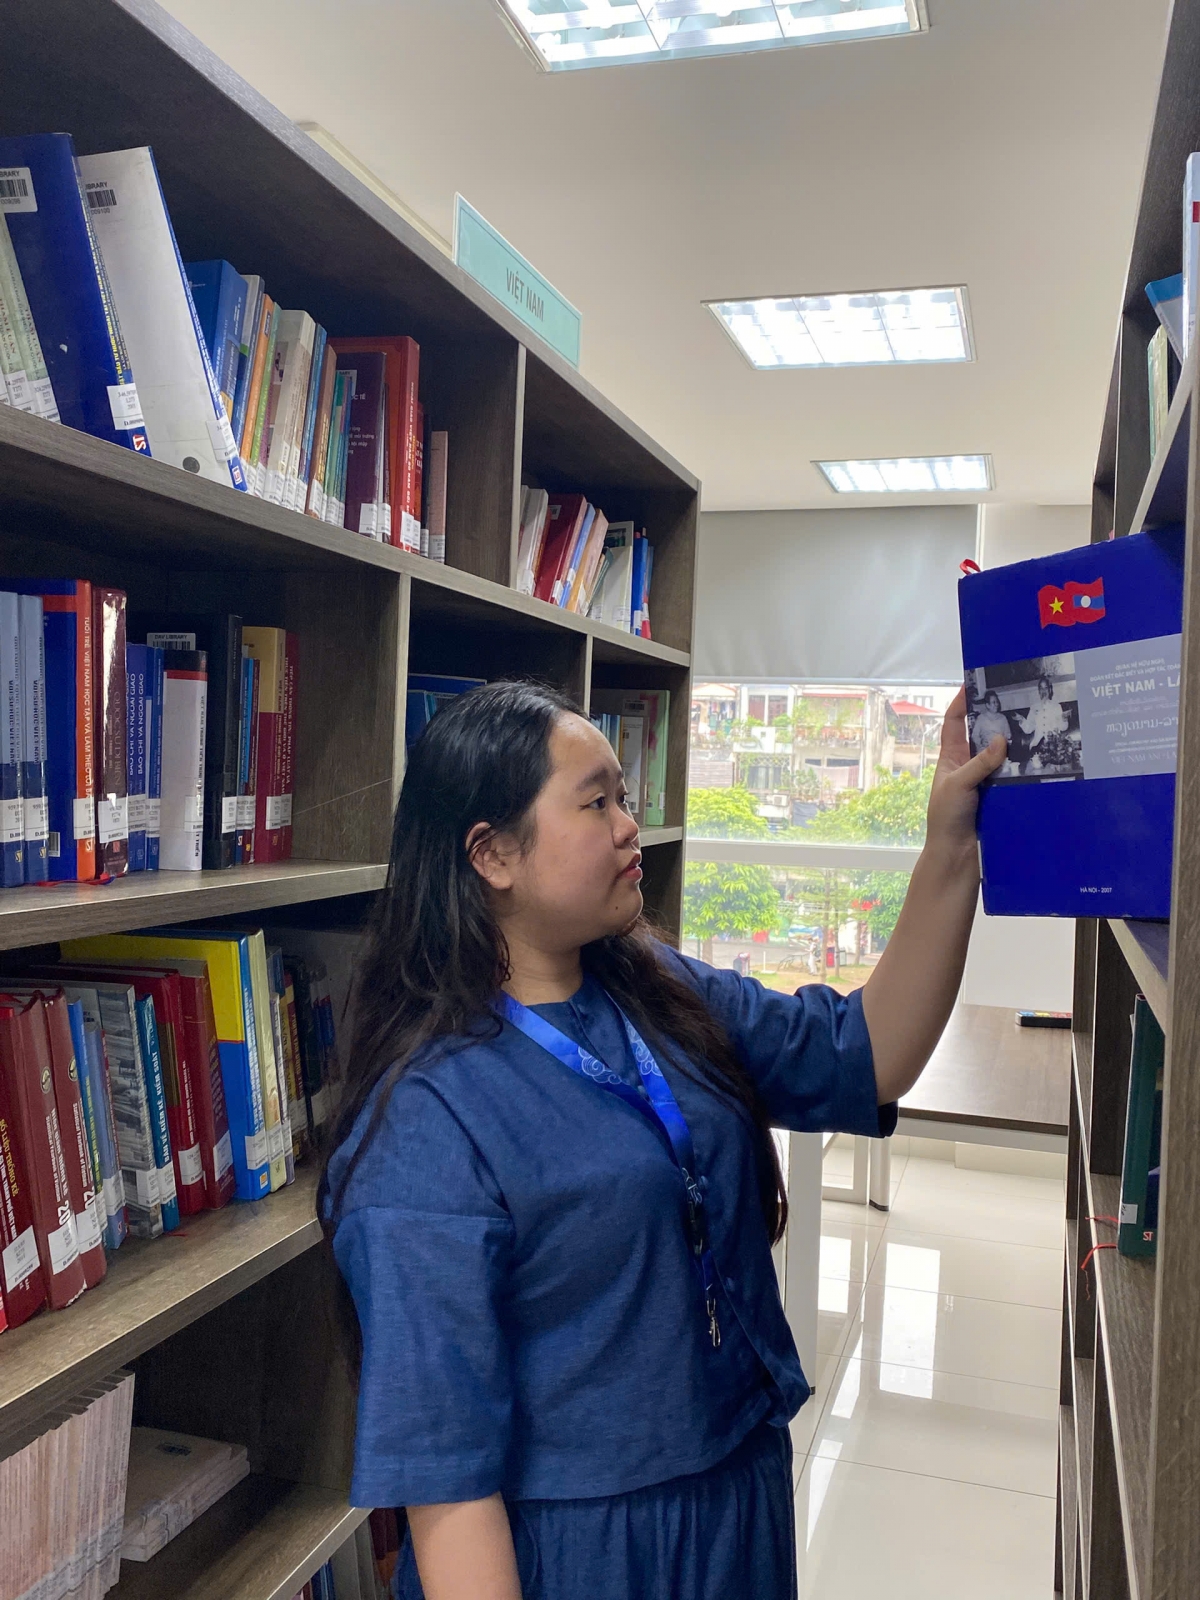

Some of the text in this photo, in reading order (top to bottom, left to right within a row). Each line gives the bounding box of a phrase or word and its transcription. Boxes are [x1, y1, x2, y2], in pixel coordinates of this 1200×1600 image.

[506, 268, 544, 322] VIỆT NAM
[132, 434, 146, 450] ST
[1091, 682, 1121, 698] VIỆT
[1125, 679, 1155, 694] NAM
[85, 722, 91, 733] VÀ
[138, 725, 143, 737] VÀ
[282, 742, 286, 752] VÀ
[286, 774, 290, 783] VÀ
[2, 1130, 11, 1153] LIỆU
[45, 1116, 53, 1144] Statistical
[49, 1145, 57, 1171] Yearbook
[162, 1132, 168, 1143] VỀ
[6, 1152, 17, 1184] THỐNG
[57, 1154, 67, 1182] thống
[62, 1183, 69, 1195] kê
[11, 1182, 19, 1197] KÊ
[57, 1200, 71, 1226] 20
[1143, 1232, 1153, 1241] ST
